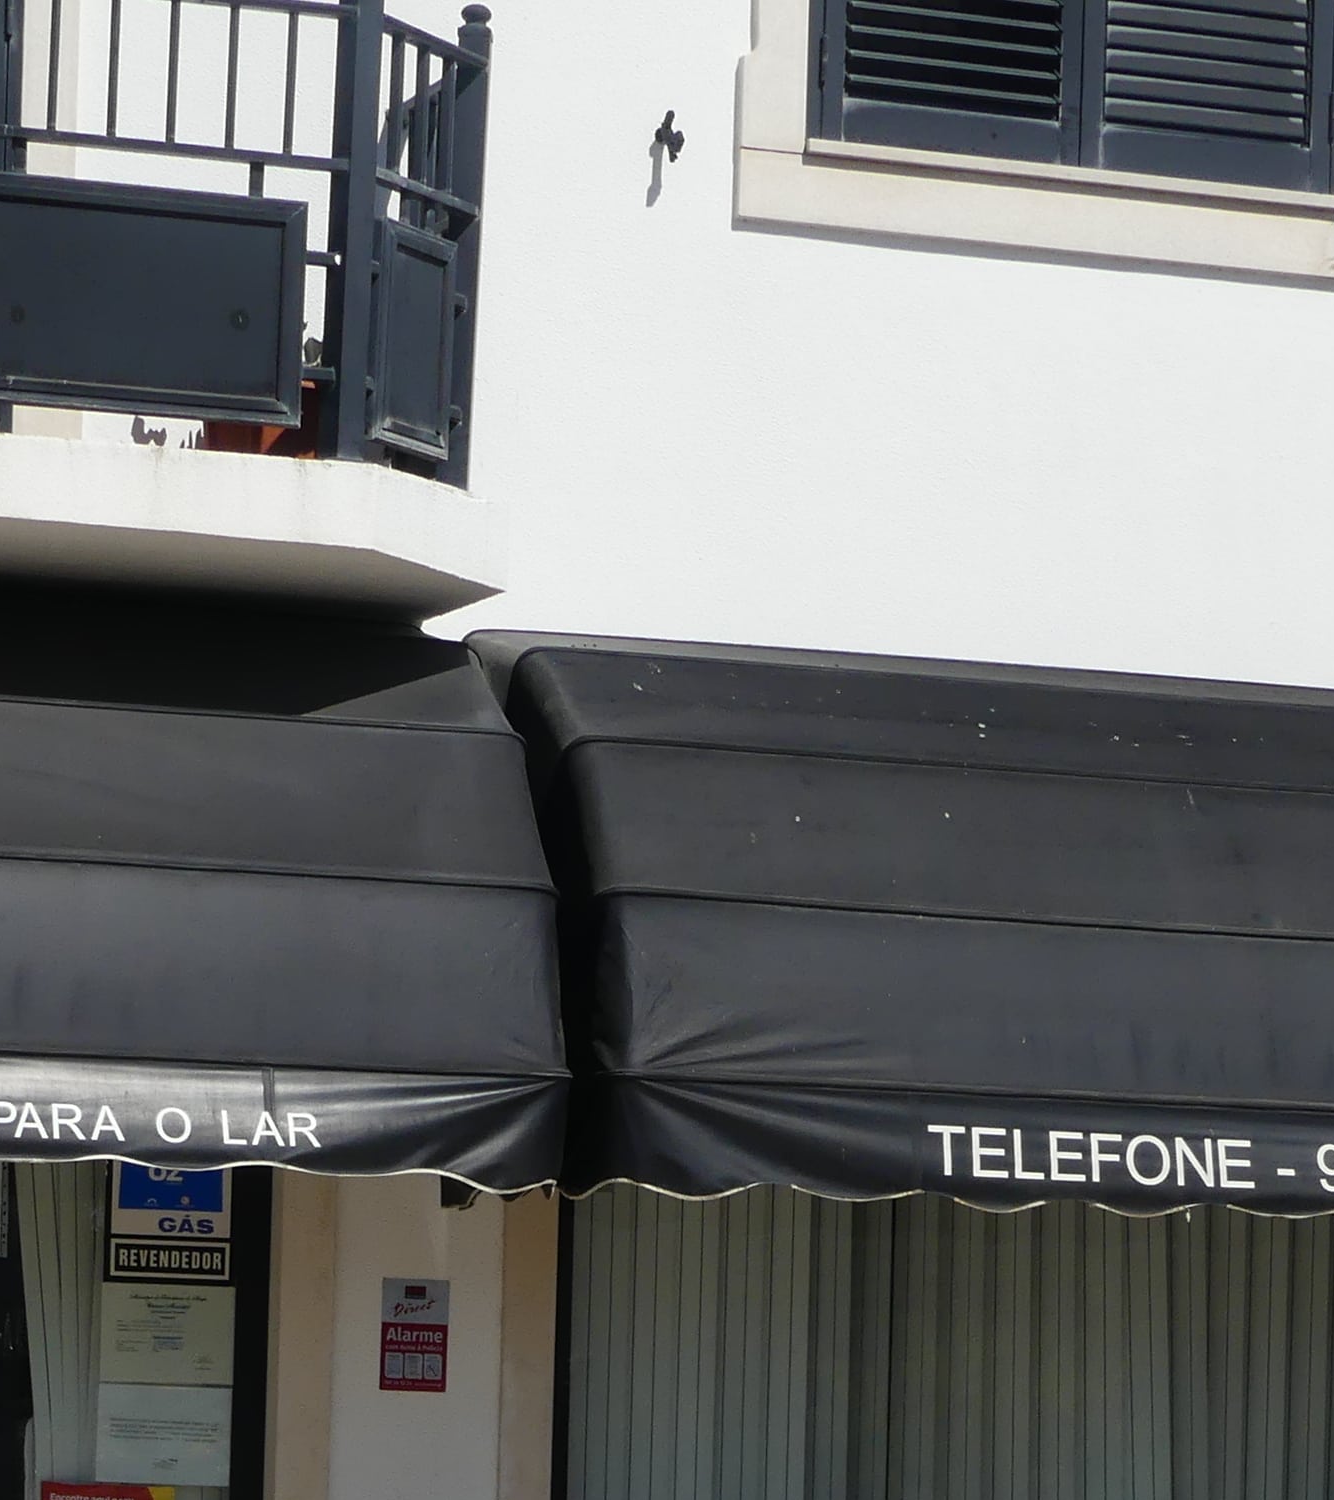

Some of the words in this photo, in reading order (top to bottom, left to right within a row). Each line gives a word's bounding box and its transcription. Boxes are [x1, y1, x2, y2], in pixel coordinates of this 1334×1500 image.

[156, 1107, 192, 1144] O
[220, 1109, 322, 1148] LAR
[927, 1124, 1256, 1190] TELEFONE
[157, 1214, 215, 1234] GÁS
[118, 1248, 222, 1270] REVENDEDOR
[387, 1326, 444, 1343] Alarme
